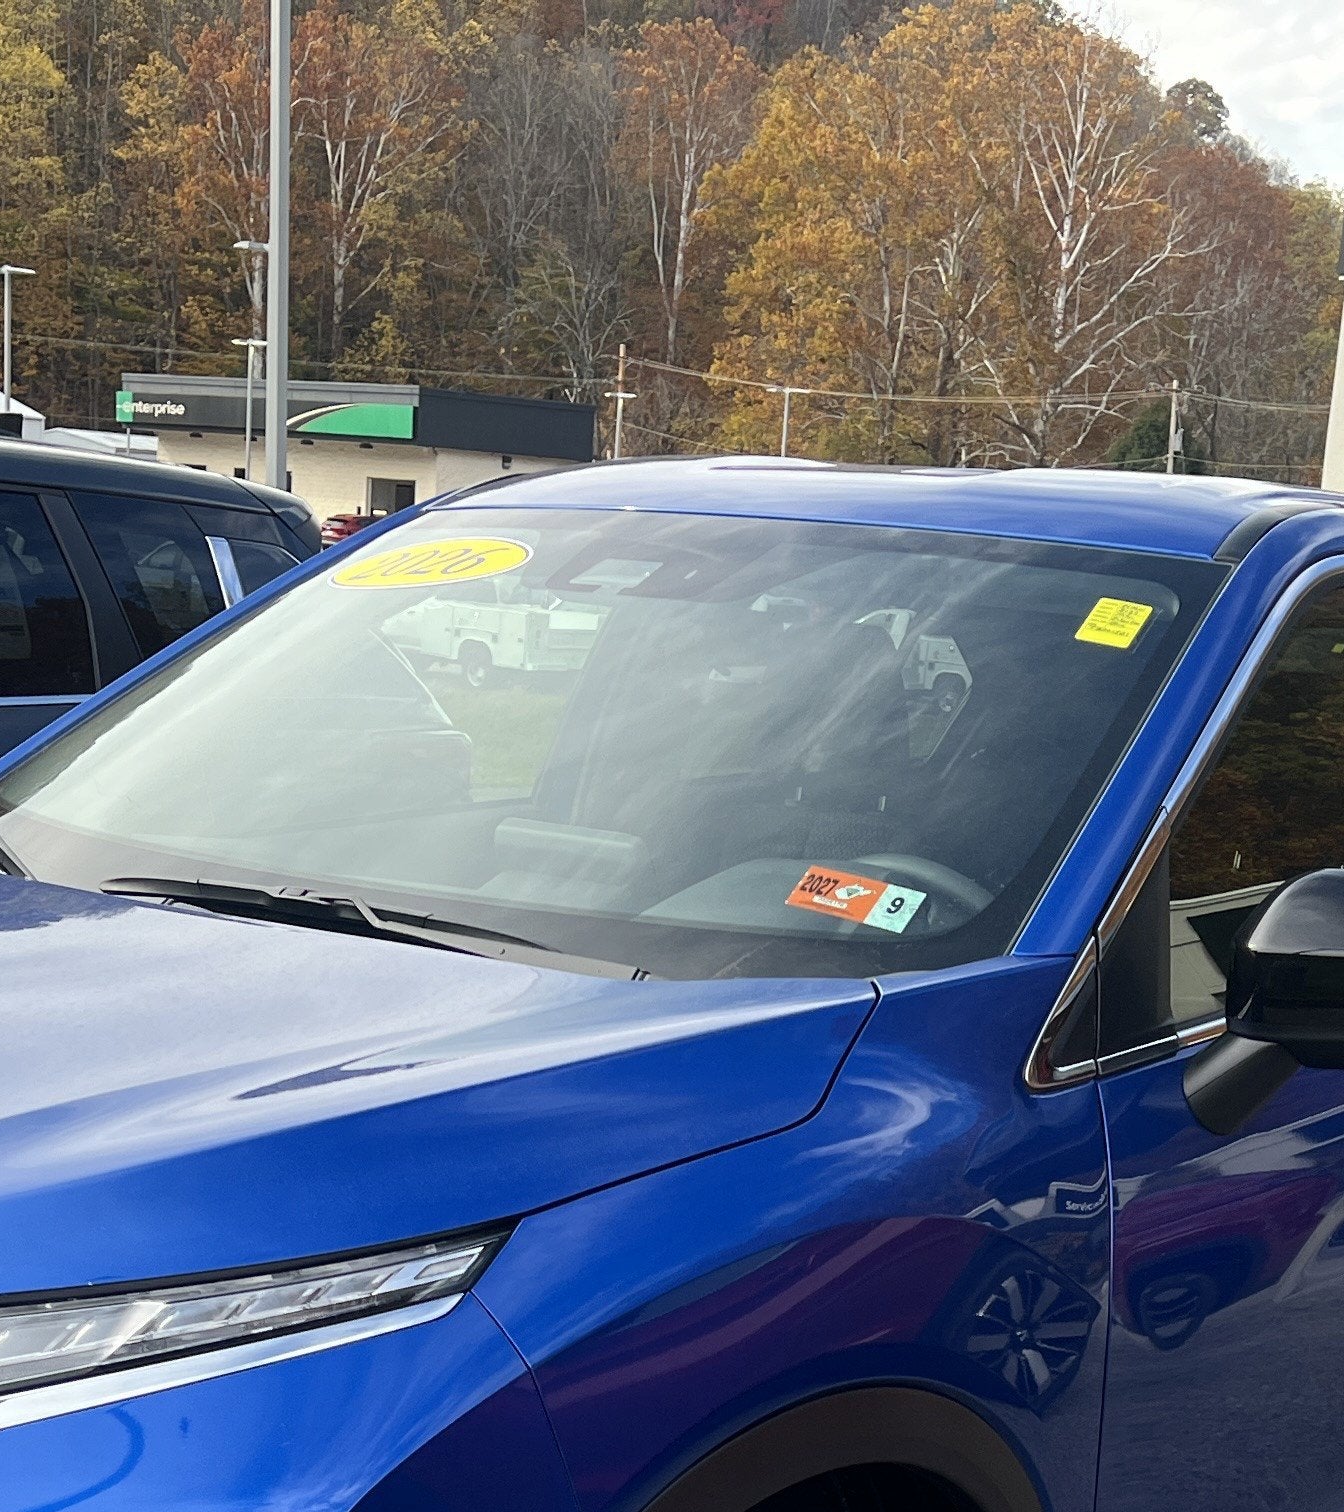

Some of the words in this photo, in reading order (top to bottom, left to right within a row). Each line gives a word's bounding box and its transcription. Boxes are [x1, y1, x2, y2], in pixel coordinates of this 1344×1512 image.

[117, 400, 185, 417] enterprise
[348, 547, 510, 580] 2026
[799, 873, 841, 897] 2027
[886, 896, 906, 914] 9
